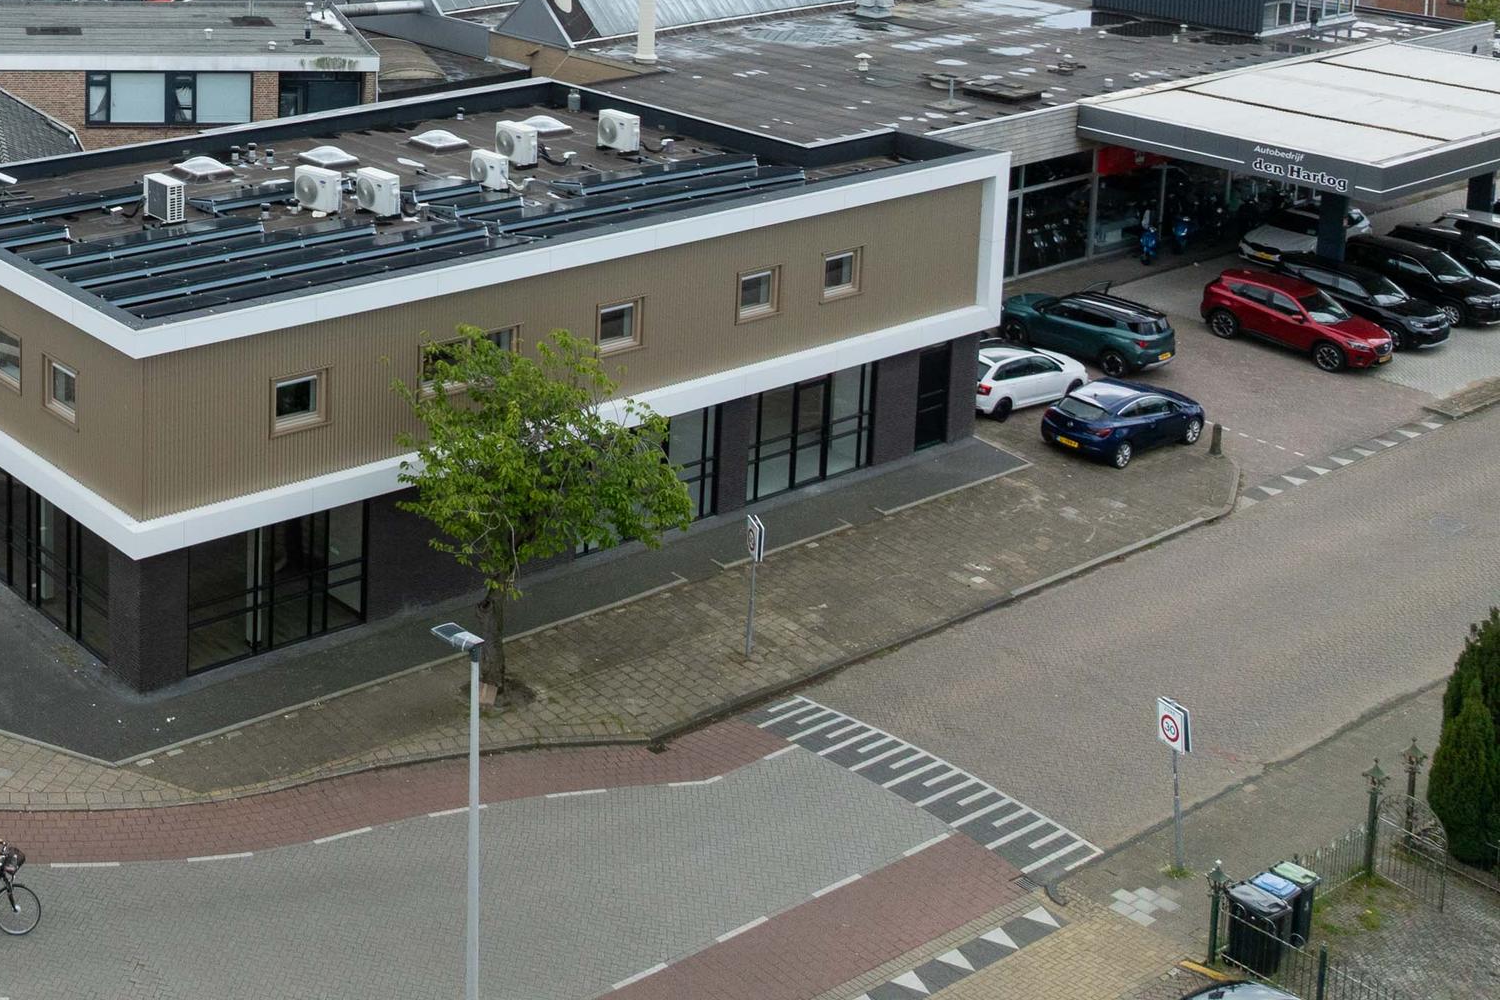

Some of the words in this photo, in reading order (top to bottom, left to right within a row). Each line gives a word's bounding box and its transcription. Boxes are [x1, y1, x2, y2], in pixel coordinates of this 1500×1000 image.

[1253, 144, 1305, 163] Autobedrijf
[1252, 157, 1285, 176] den
[1287, 164, 1348, 192] Hartog
[1165, 721, 1176, 736] 30
